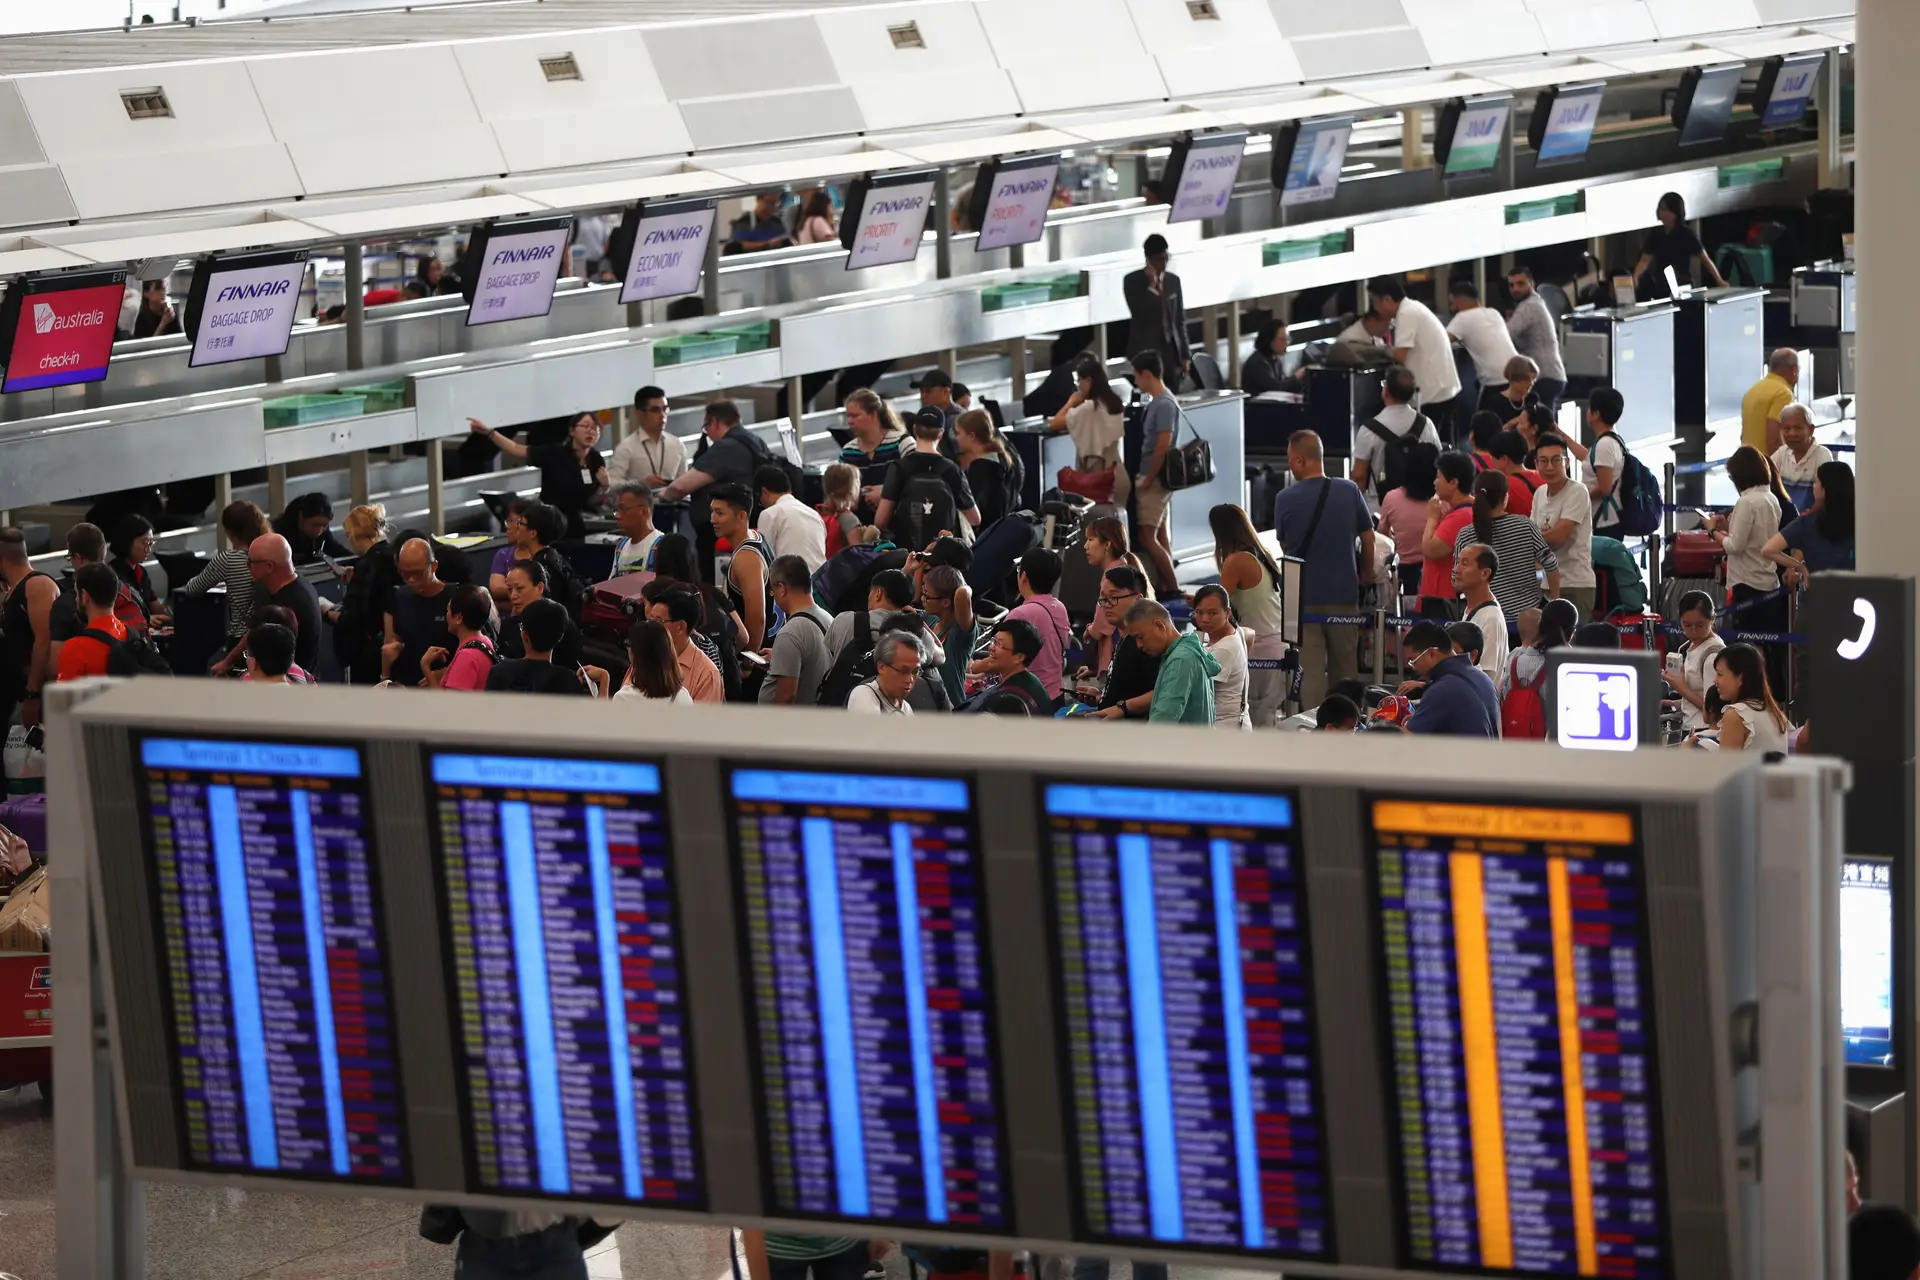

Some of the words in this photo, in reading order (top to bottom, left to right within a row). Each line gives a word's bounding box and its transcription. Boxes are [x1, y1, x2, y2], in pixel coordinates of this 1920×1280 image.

[998, 179, 1048, 198] FINNAIR
[869, 196, 923, 215] FINNAIR
[644, 225, 703, 246] FINNAIR
[492, 245, 555, 266] FINNAIR
[636, 251, 682, 273] ECONOMY
[112, 272, 126, 283] E31
[486, 273, 519, 290] BAGGAGE
[519, 271, 540, 286] DROP
[216, 279, 291, 303] FINNAIR
[54, 309, 105, 330] australia
[210, 310, 250, 329] BAGGAGE
[250, 307, 274, 323] DROP
[39, 351, 80, 369] check-in
[1326, 616, 1366, 624] FINNAIR
[1737, 632, 1780, 642] FINNAIR
